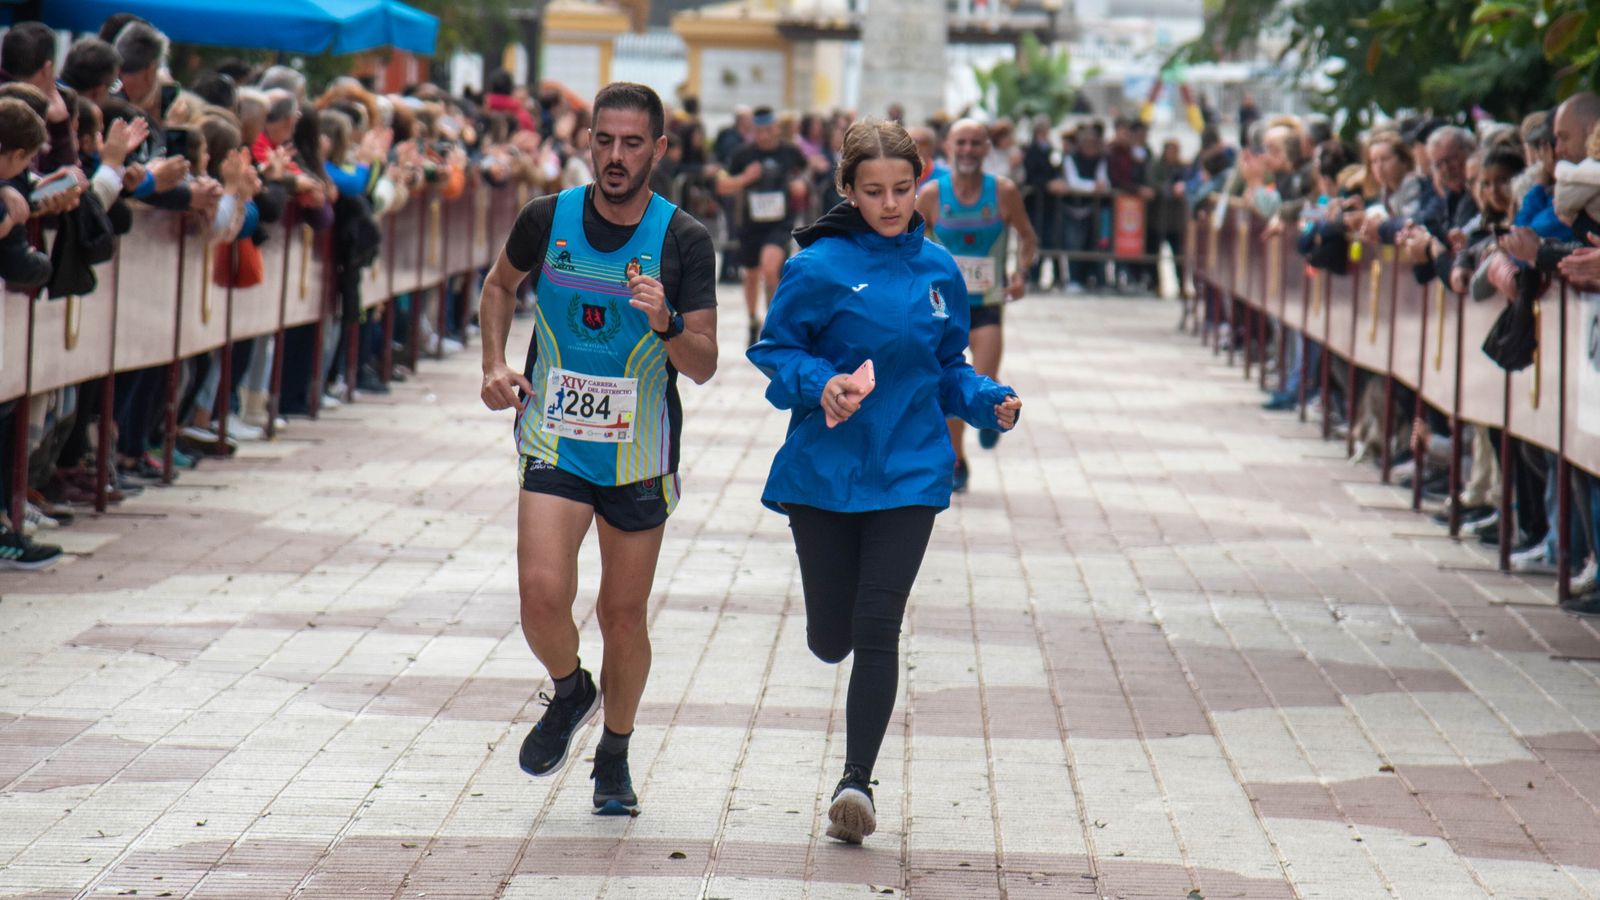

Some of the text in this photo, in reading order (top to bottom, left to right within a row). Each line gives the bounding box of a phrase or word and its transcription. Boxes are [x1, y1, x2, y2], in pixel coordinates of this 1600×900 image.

[561, 375, 587, 391] XIV
[588, 380, 618, 388] CARRERA
[564, 390, 611, 420] 284
